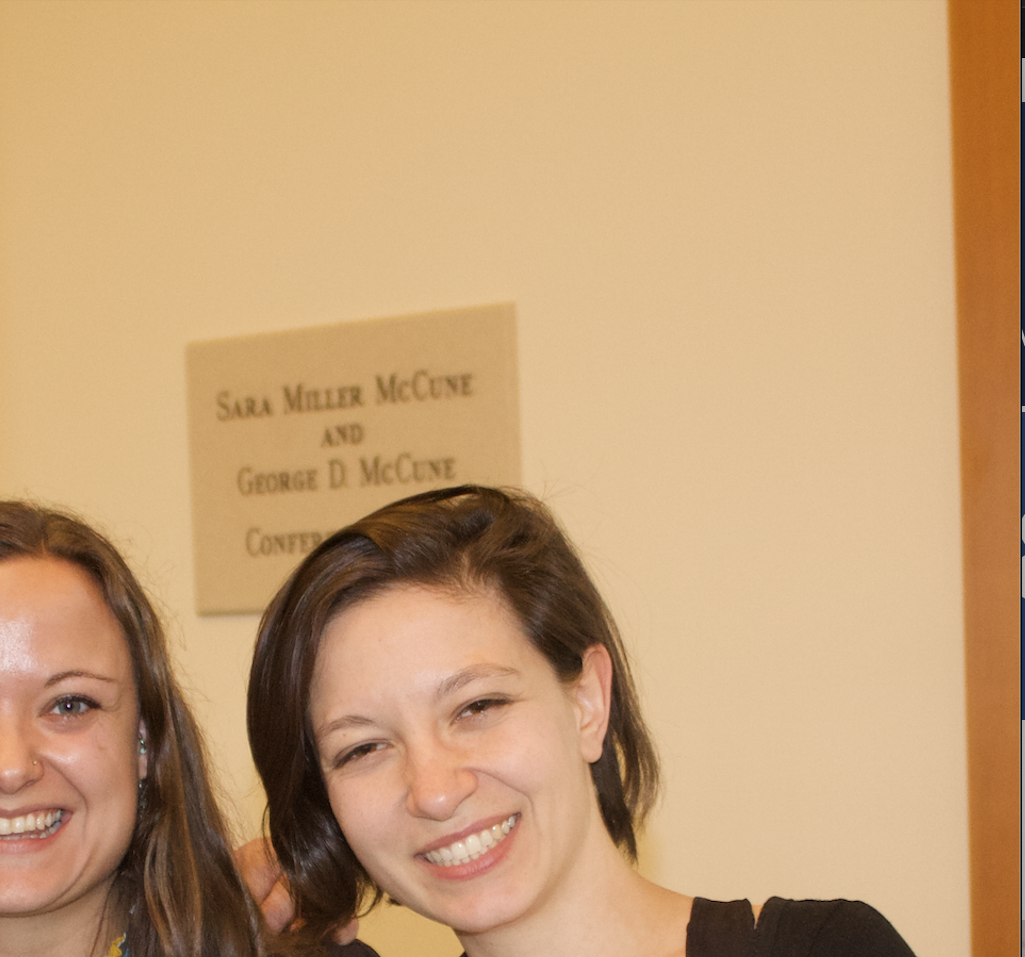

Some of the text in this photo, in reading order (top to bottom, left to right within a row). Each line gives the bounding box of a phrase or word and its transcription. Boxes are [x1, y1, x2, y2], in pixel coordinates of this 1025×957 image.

[216, 391, 273, 422] SARA
[283, 384, 363, 415] MILLER
[321, 422, 364, 448] AND
[237, 466, 319, 496] GEORGE
